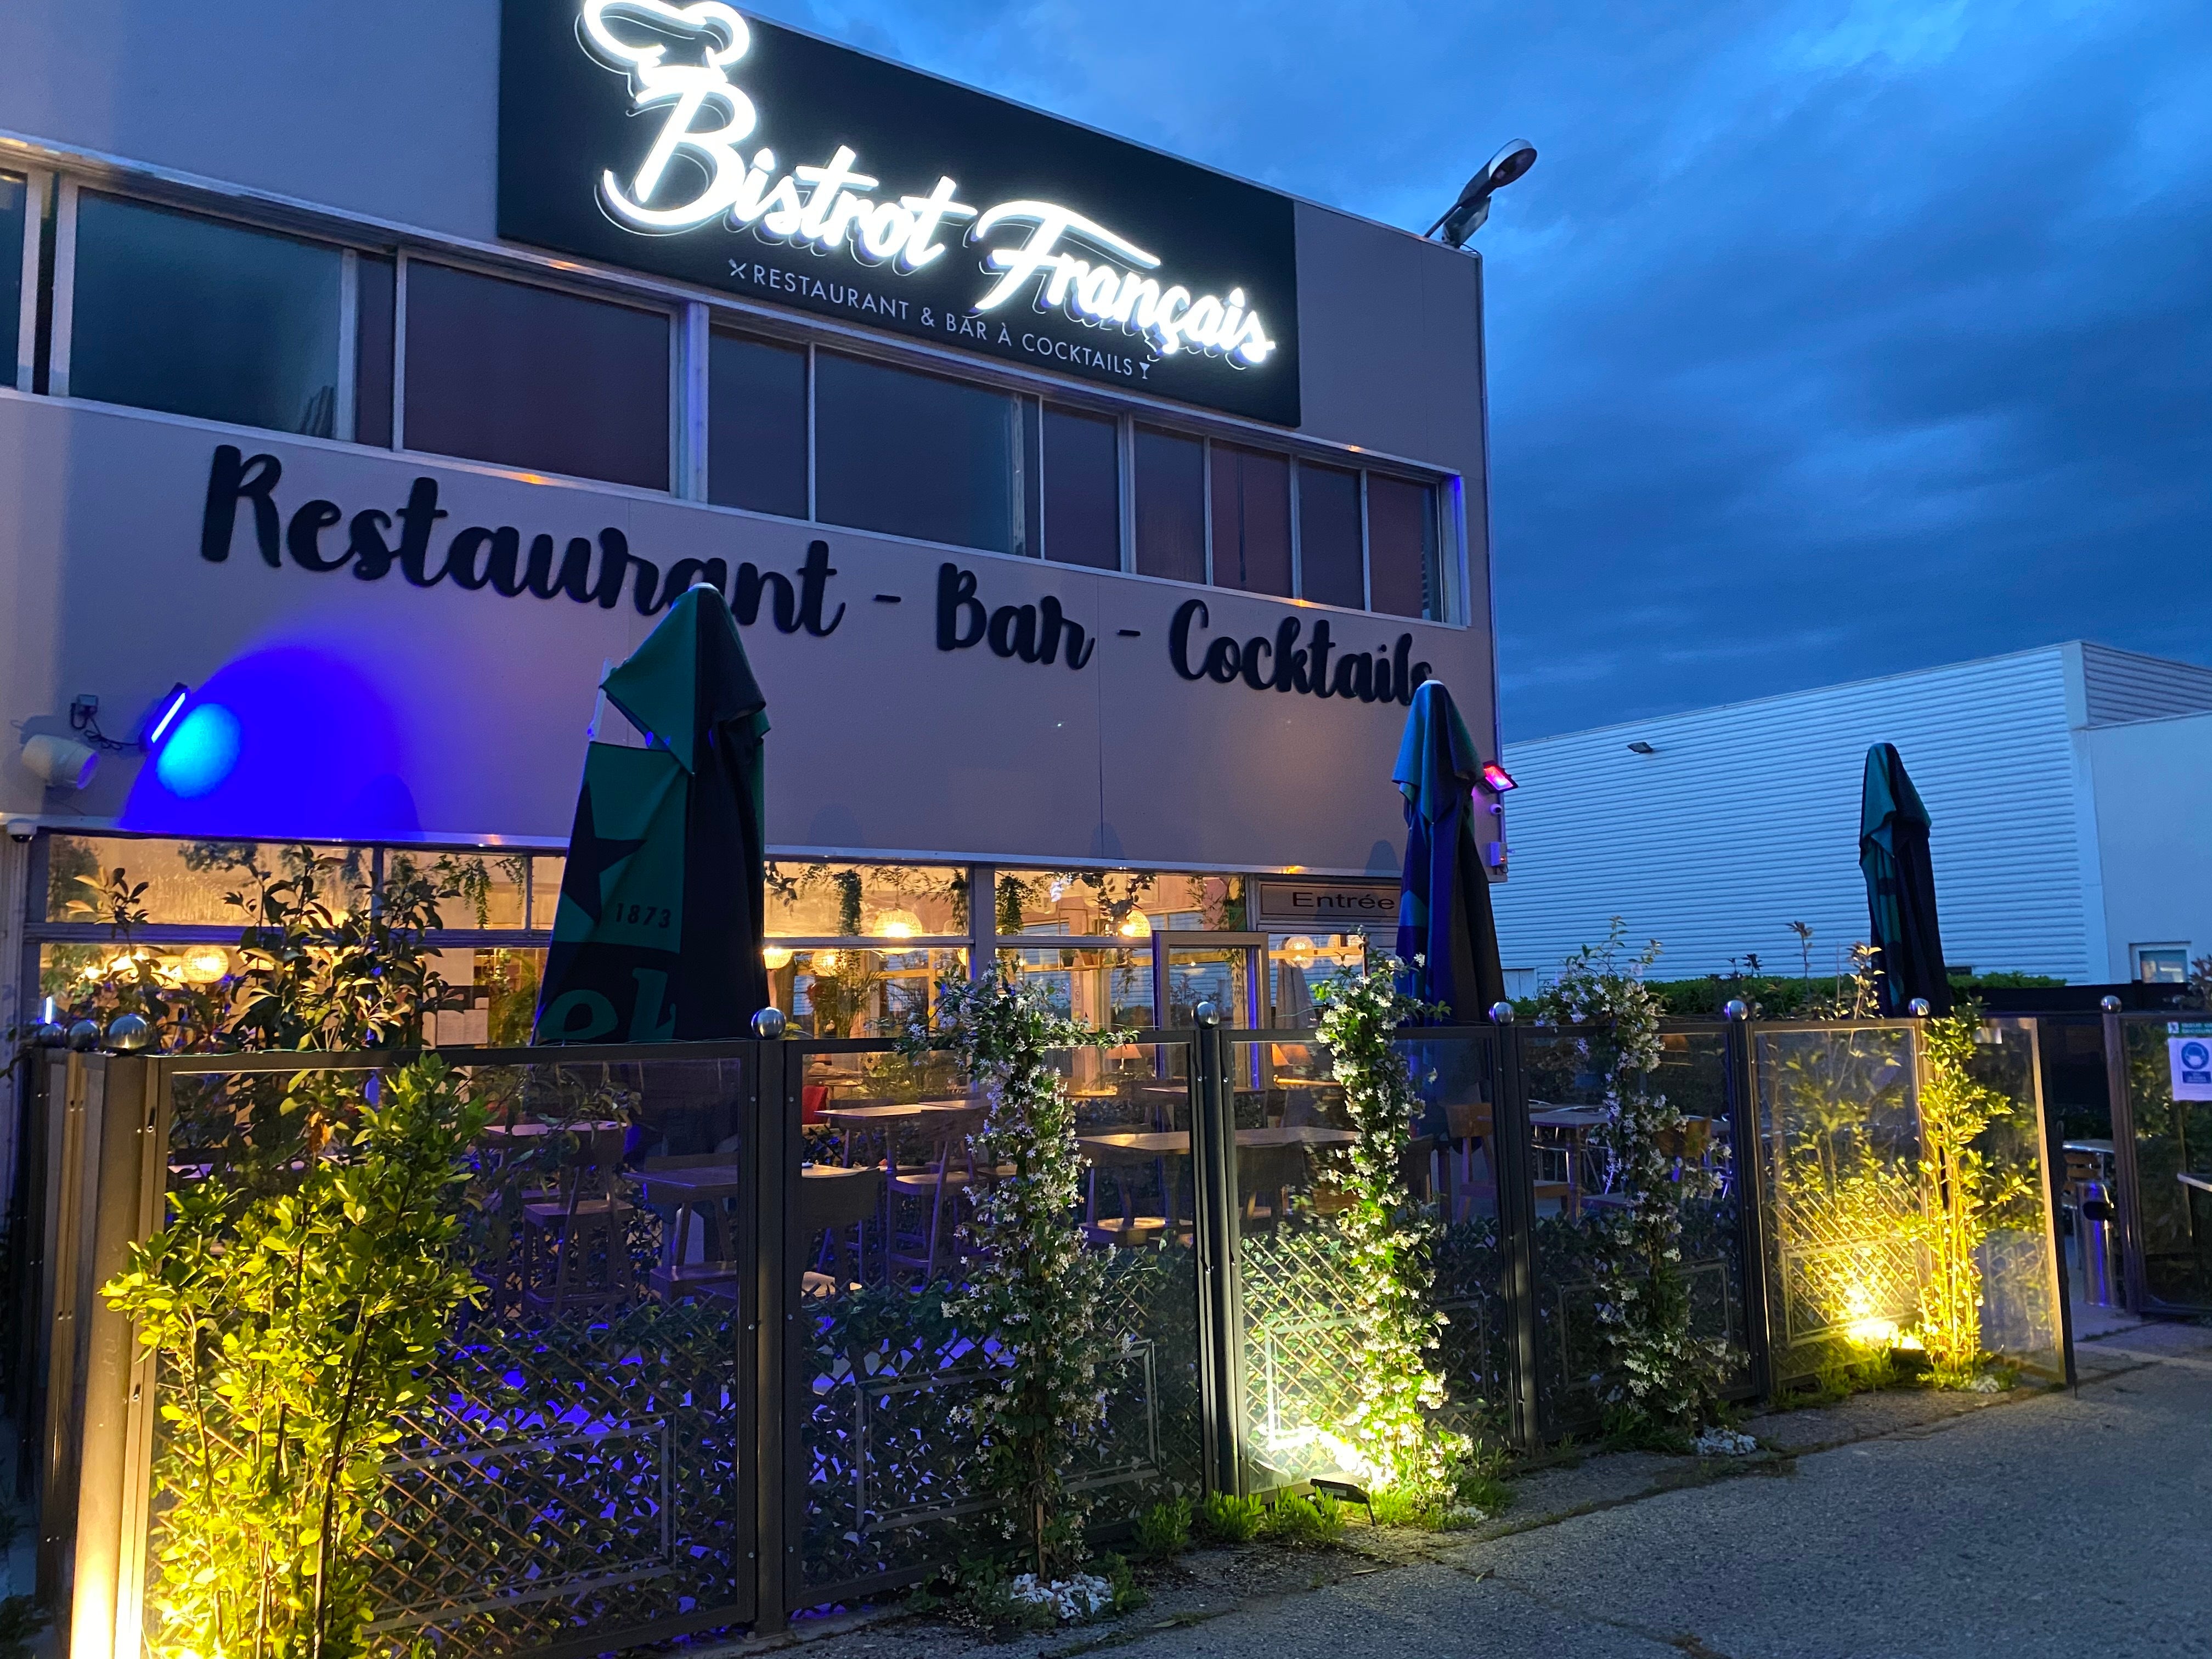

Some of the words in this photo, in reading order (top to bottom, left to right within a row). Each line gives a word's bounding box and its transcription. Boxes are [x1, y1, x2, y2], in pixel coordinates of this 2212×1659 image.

[602, 76, 979, 269] Bistrot
[973, 200, 1276, 363] Français
[753, 264, 909, 320] RESTAURANT
[921, 307, 935, 328] &
[946, 313, 988, 341] BAR
[997, 322, 1012, 347] À
[1022, 332, 1133, 376] COCKTAILS
[200, 444, 845, 637] Restaurant
[936, 562, 1095, 670] Bar
[615, 902, 672, 928] 1873
[1293, 891, 1395, 910] Entrée
